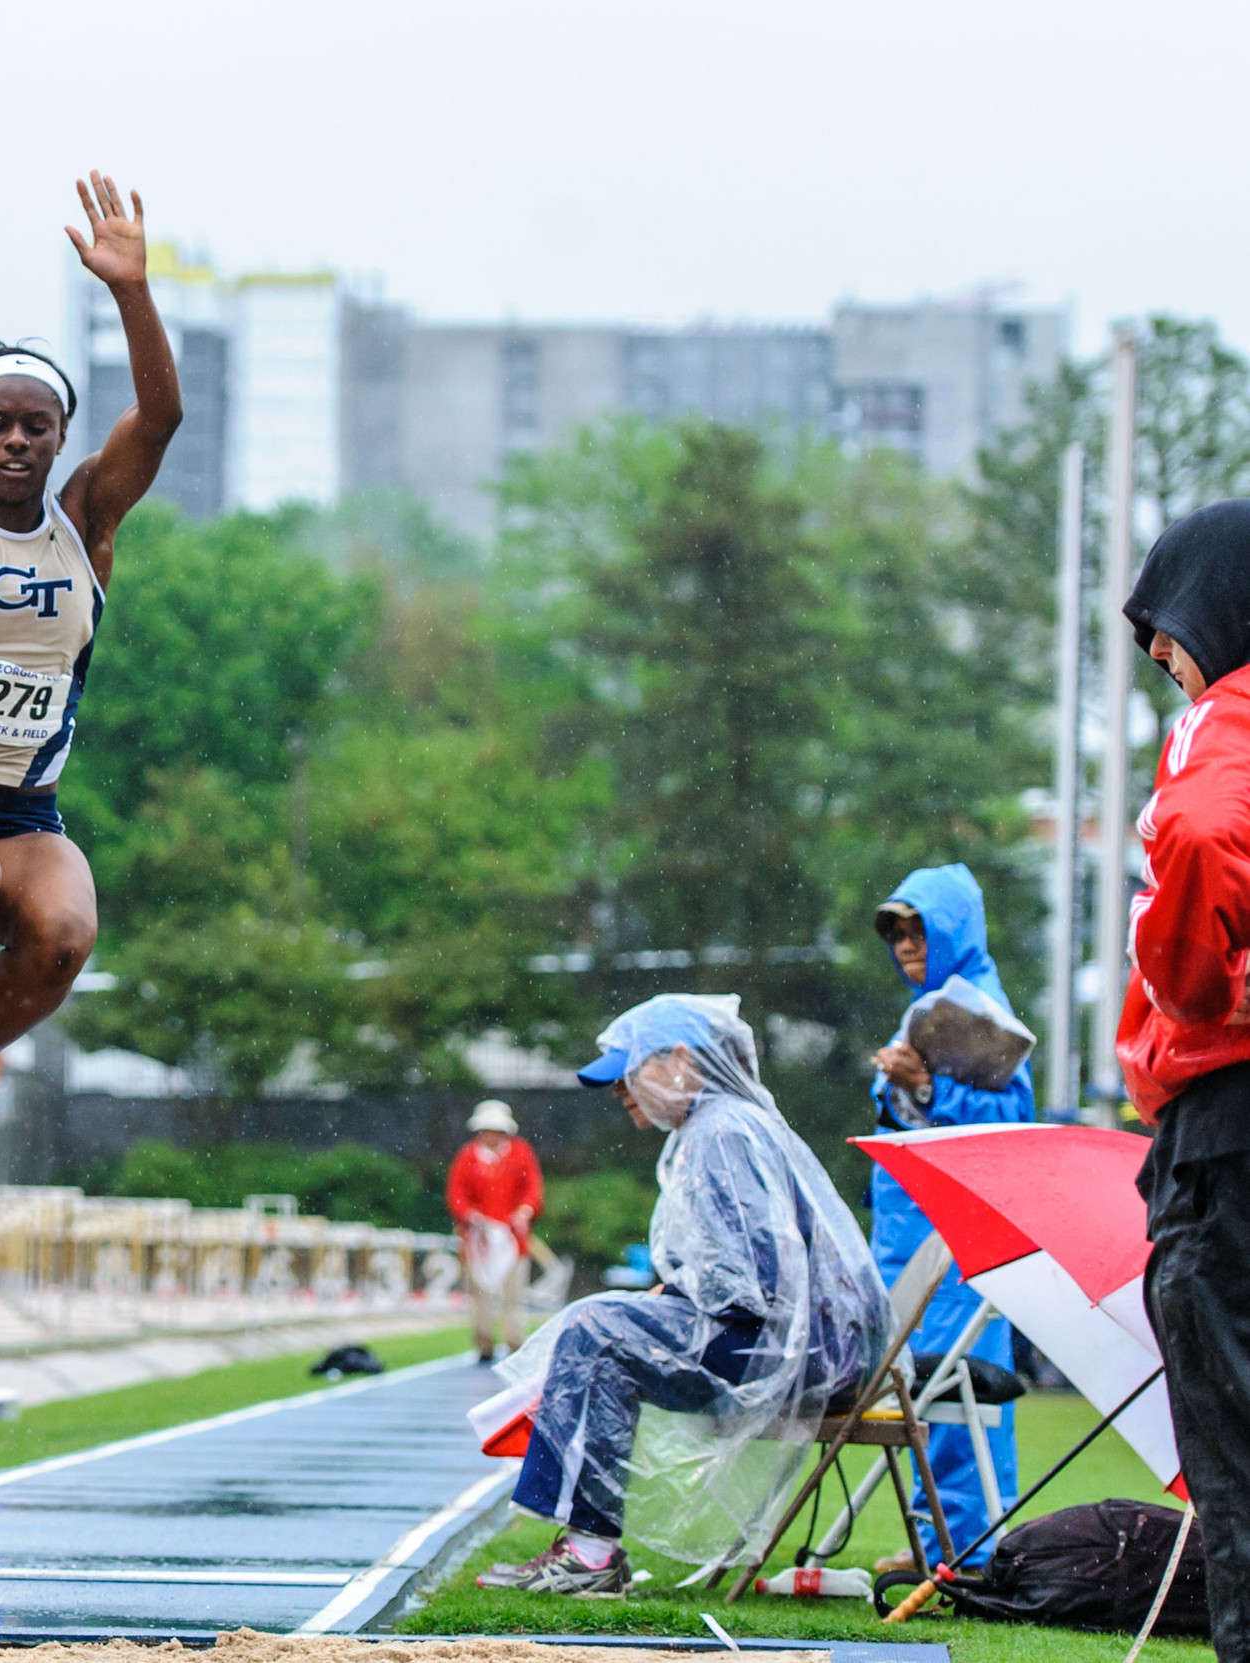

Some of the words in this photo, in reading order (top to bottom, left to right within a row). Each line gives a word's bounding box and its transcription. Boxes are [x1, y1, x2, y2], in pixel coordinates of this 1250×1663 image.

[11, 728, 19, 737] &
[22, 729, 49, 739] FIELD
[422, 1252, 462, 1299] 2
